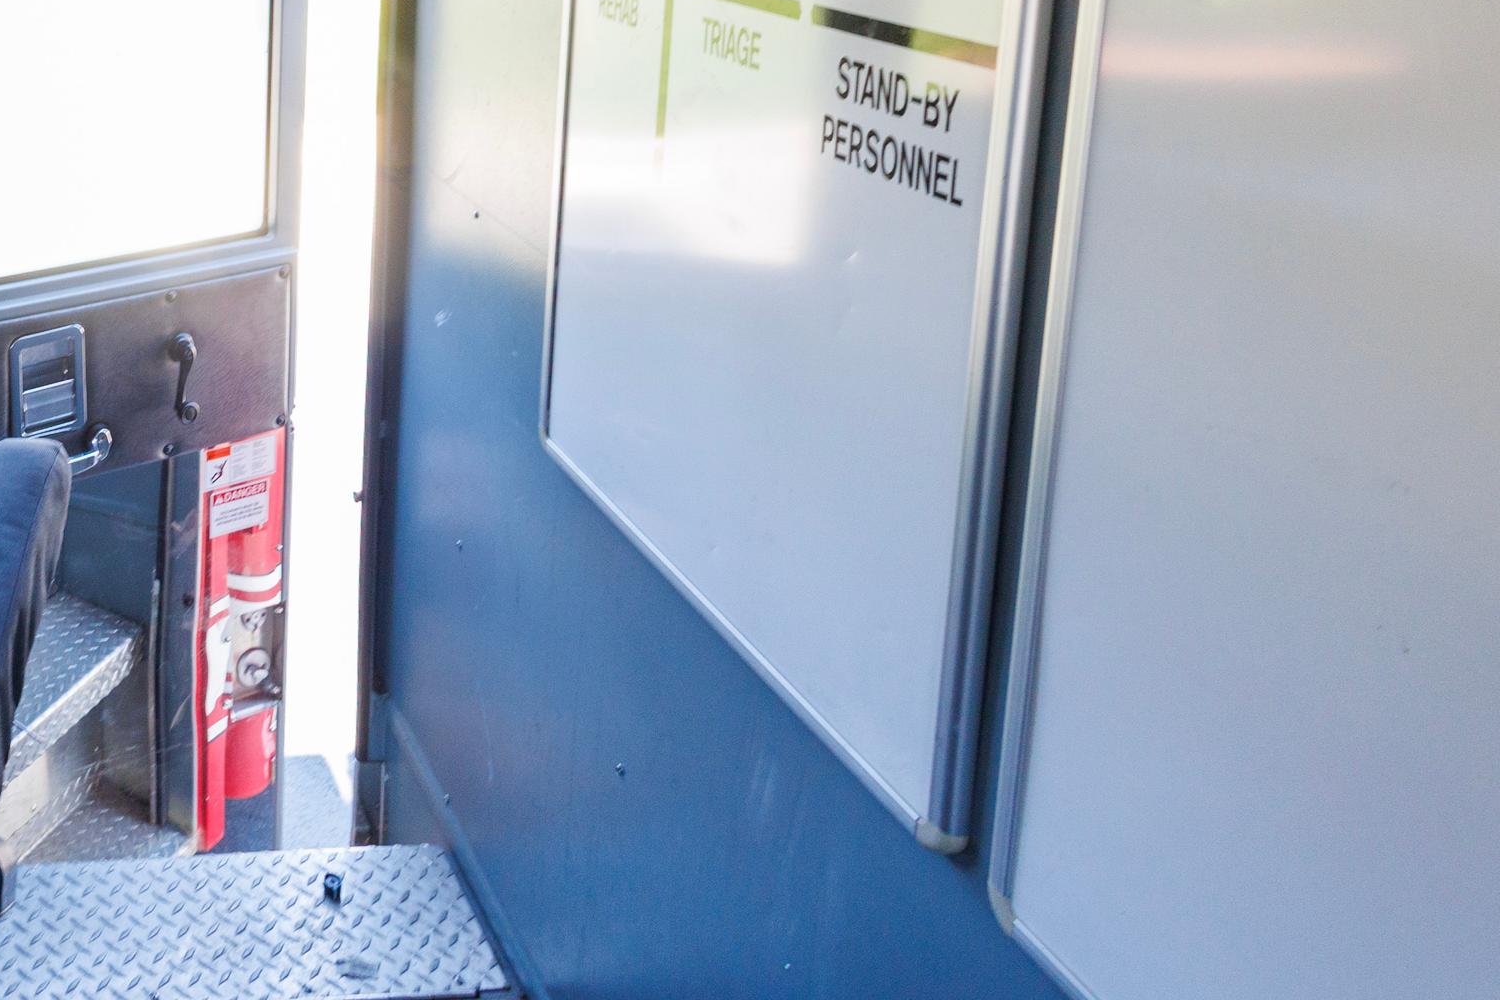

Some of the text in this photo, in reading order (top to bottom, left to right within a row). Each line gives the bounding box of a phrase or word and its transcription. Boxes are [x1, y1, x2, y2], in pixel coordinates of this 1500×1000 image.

[703, 18, 762, 70] TRIAGE
[836, 56, 961, 133] STAND-BY
[821, 116, 963, 207] PERSONNEL
[223, 483, 267, 503] DANGER
